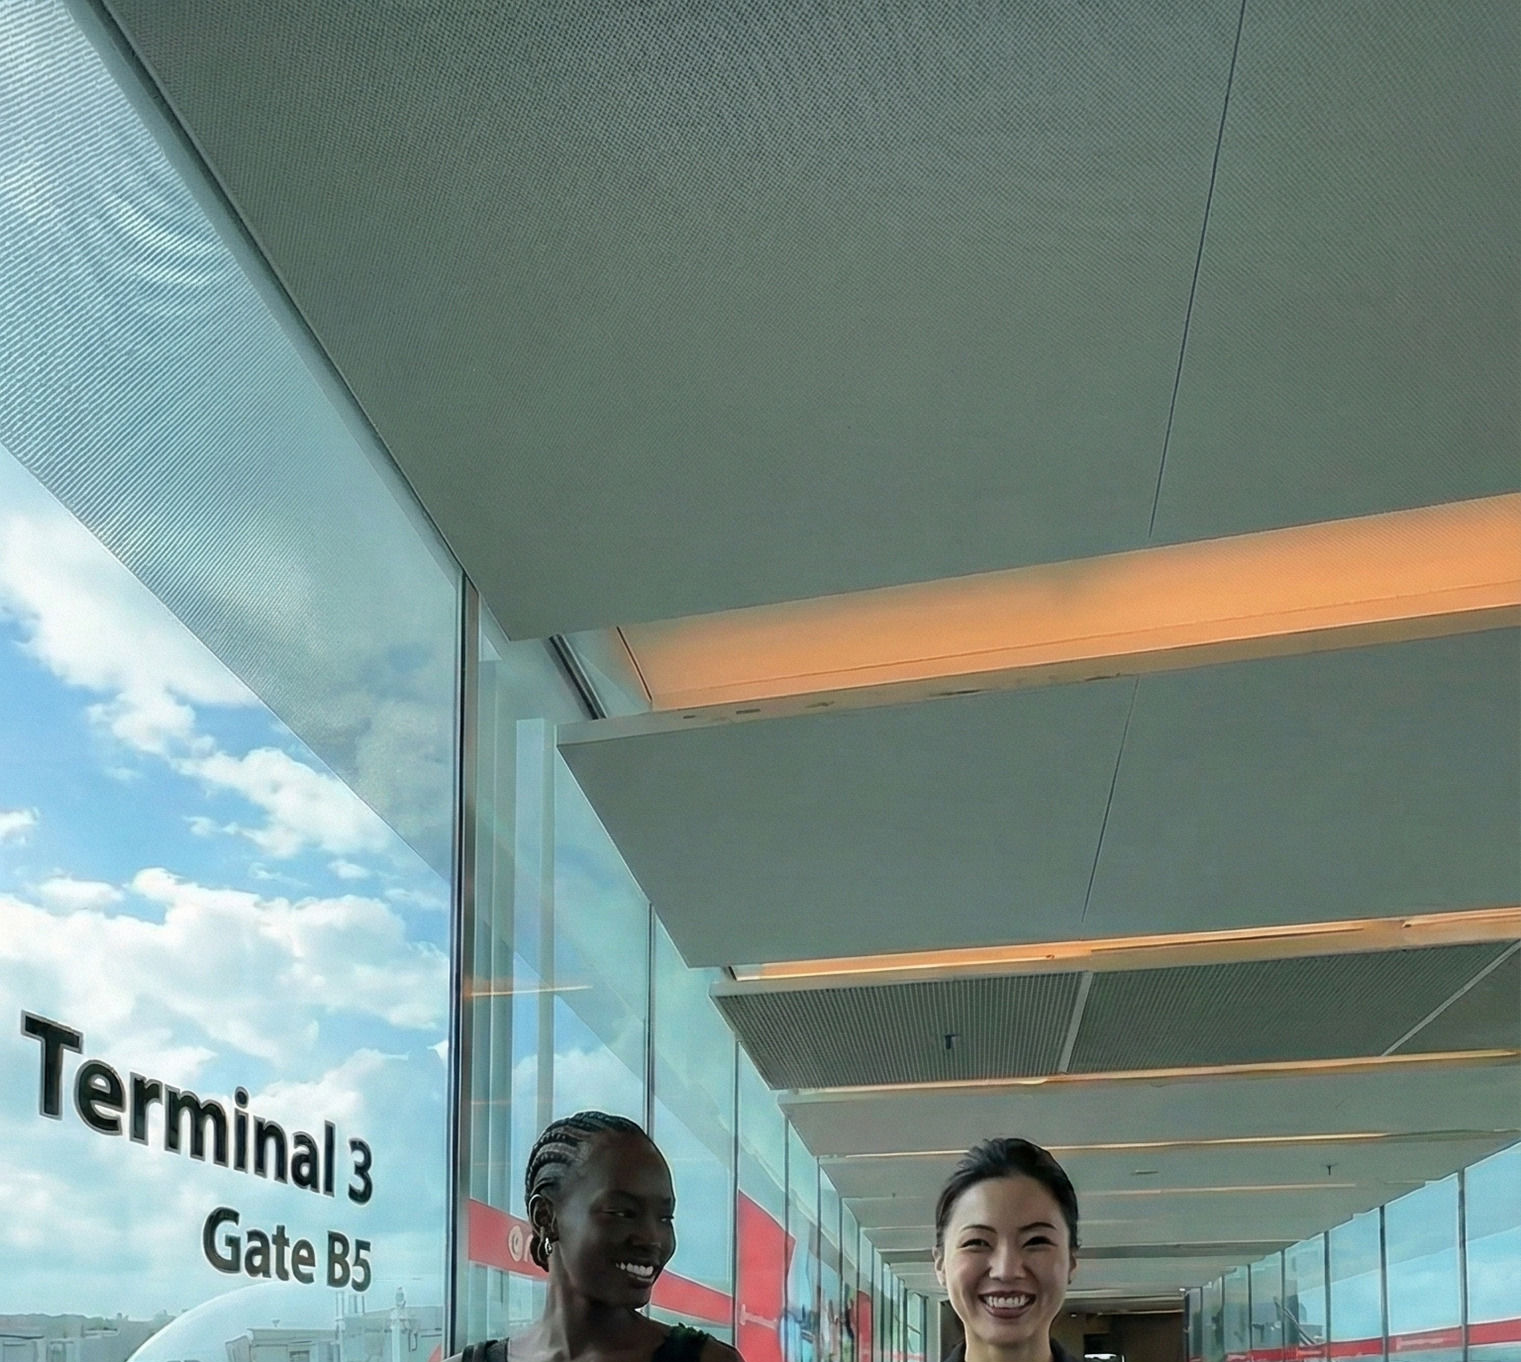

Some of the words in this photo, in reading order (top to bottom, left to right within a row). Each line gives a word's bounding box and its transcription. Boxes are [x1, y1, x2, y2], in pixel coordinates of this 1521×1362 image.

[21, 1010, 336, 1198] Terminal
[347, 1138, 373, 1205] 3
[202, 1206, 316, 1284] Gate
[326, 1230, 372, 1293] B5
